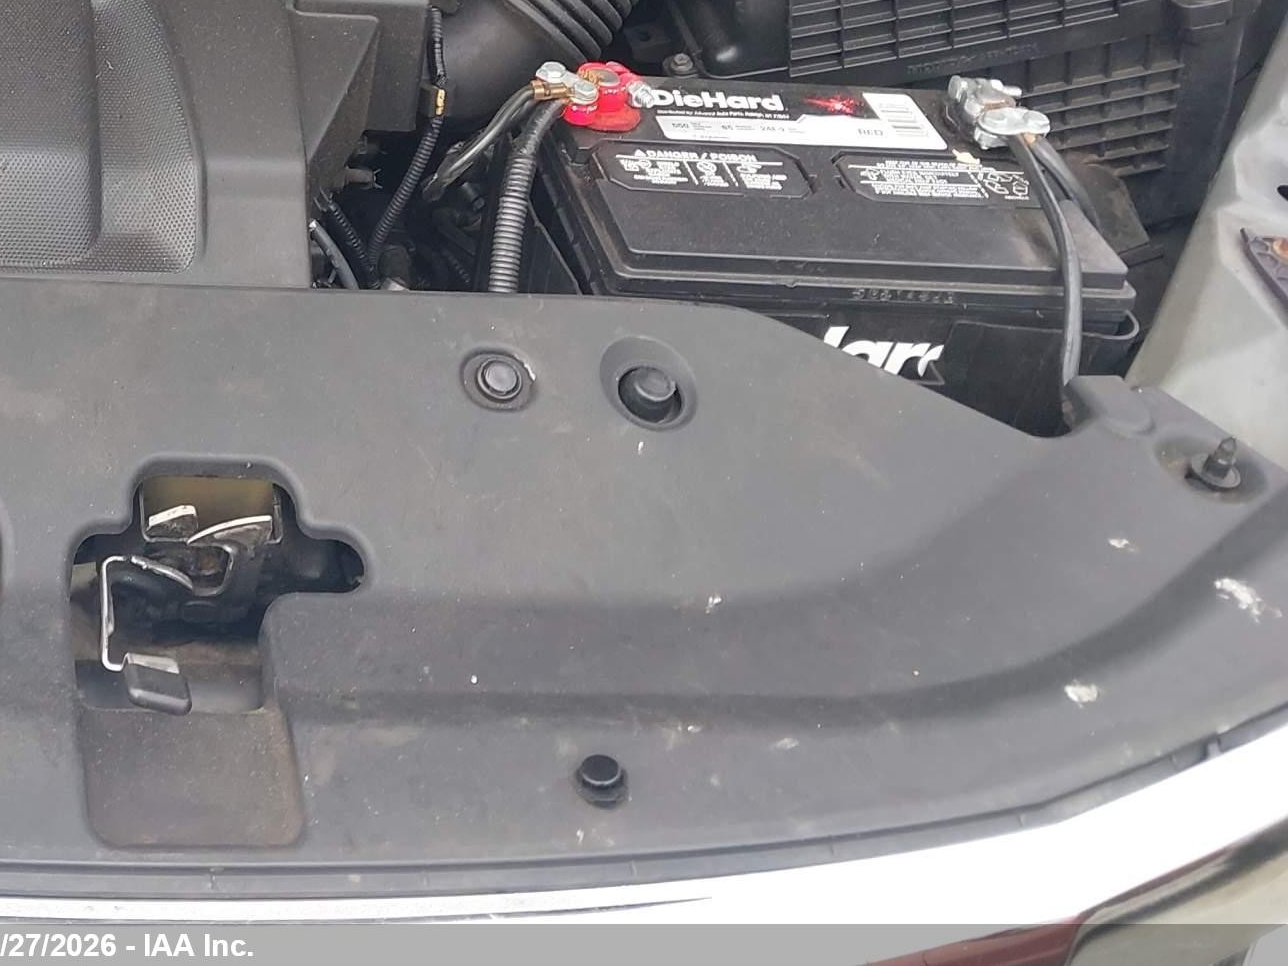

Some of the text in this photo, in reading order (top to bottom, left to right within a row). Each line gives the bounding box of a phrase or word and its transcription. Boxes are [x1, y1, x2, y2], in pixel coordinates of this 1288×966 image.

[652, 89, 784, 111] DieHard
[646, 150, 699, 159] DANGER
[710, 152, 758, 162] POISON
